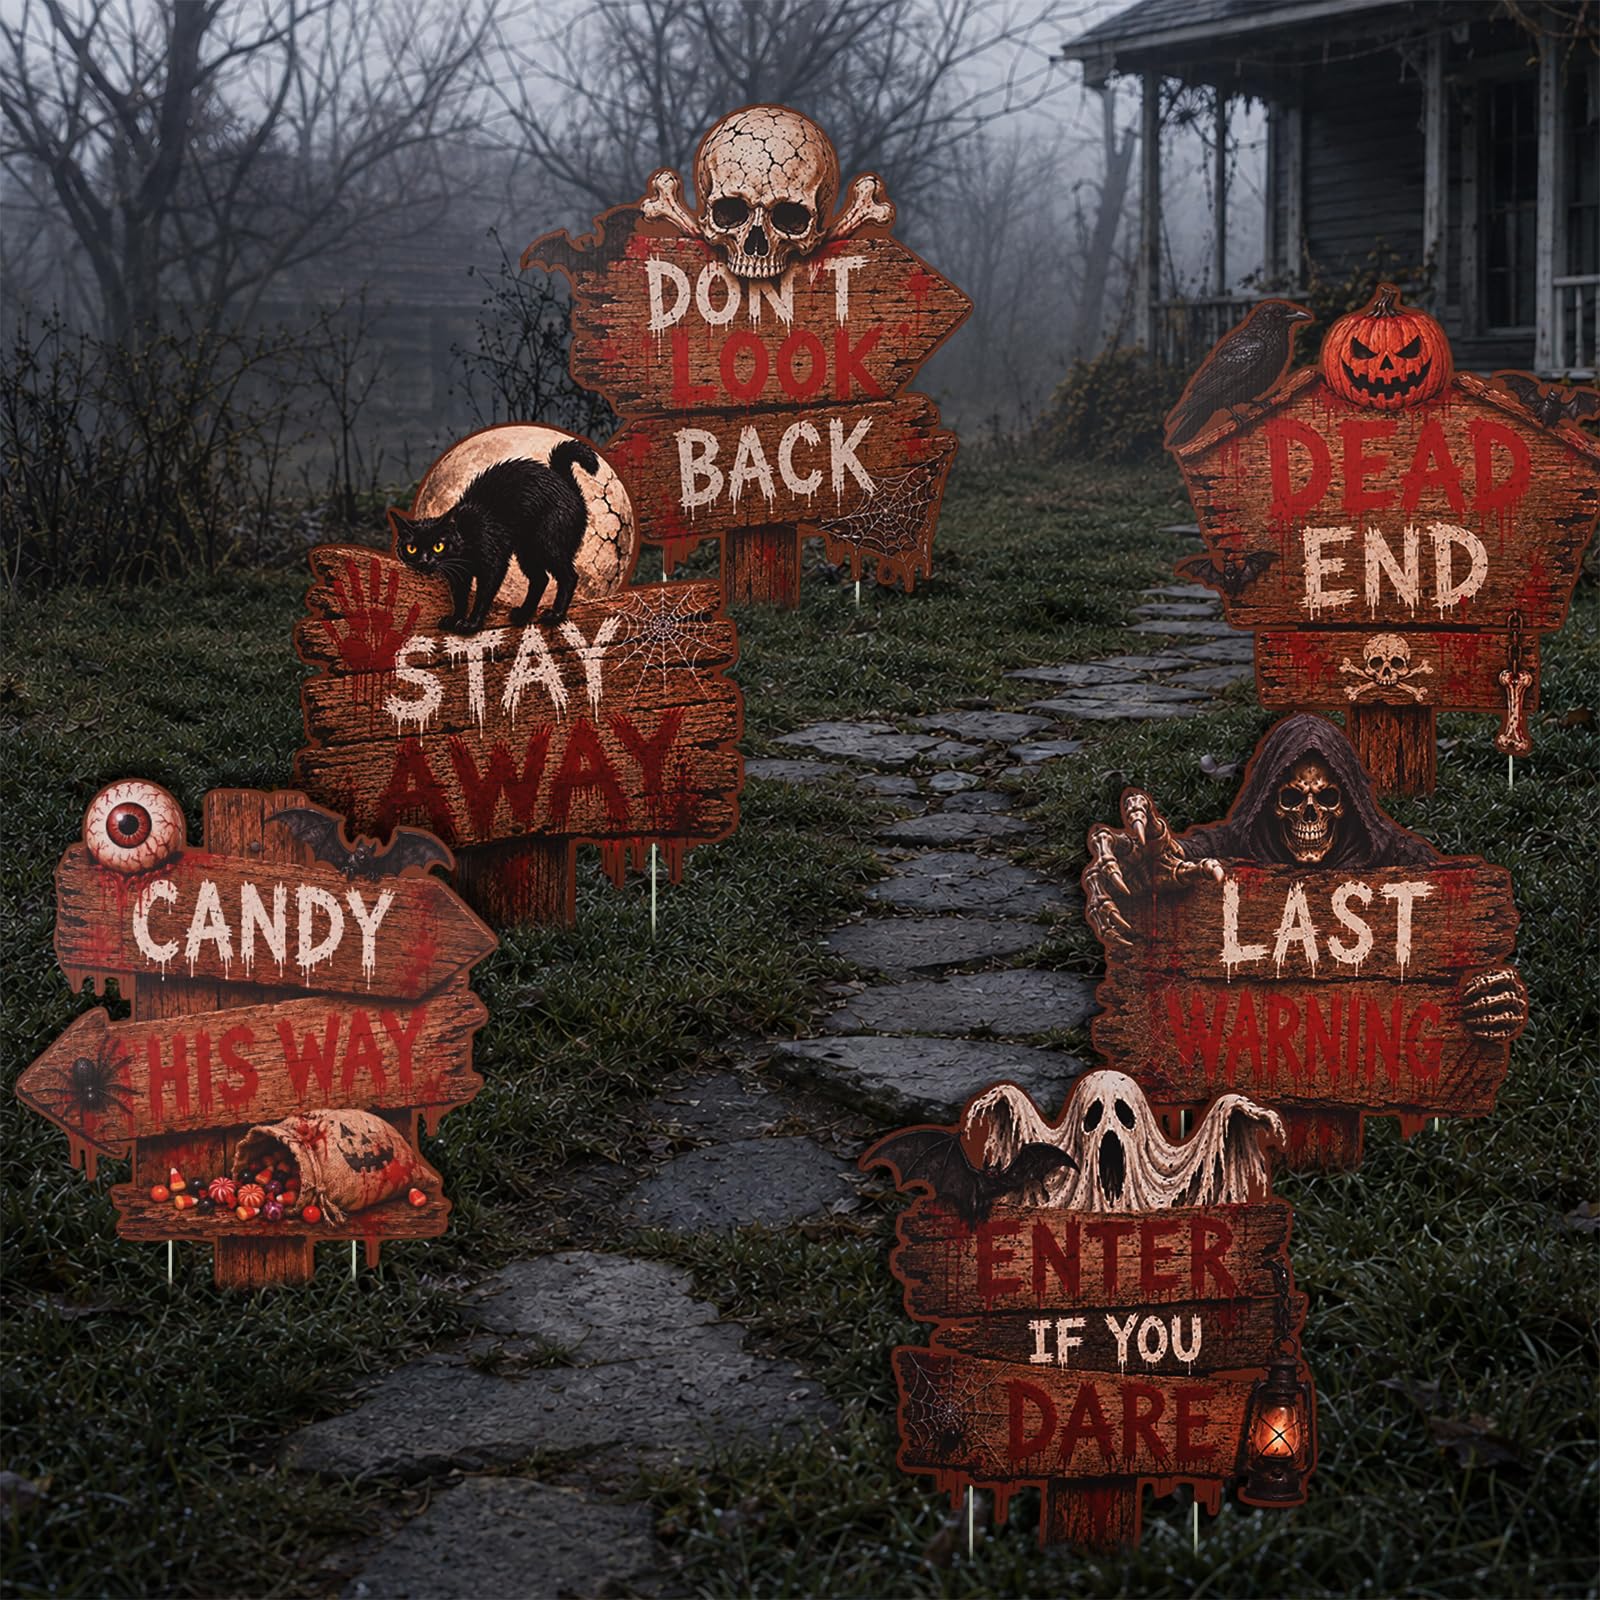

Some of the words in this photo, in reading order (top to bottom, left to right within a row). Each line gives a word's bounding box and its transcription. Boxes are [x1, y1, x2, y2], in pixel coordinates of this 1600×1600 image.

[671, 326, 887, 404] LOOK
[675, 416, 877, 516] BACK
[1265, 416, 1532, 520] DEAD
[1300, 521, 1488, 616] END
[384, 616, 622, 738] STAY
[372, 706, 686, 836] AWAY
[133, 879, 396, 984] CANDY
[1219, 878, 1436, 978] LAST
[277, 1006, 428, 1102] WAY
[1166, 988, 1446, 1090] WARNING
[974, 1216, 1243, 1302] ENTER
[1028, 1317, 1087, 1372] IF
[1104, 1312, 1202, 1374] YOU
[1006, 1378, 1221, 1471] DARE
